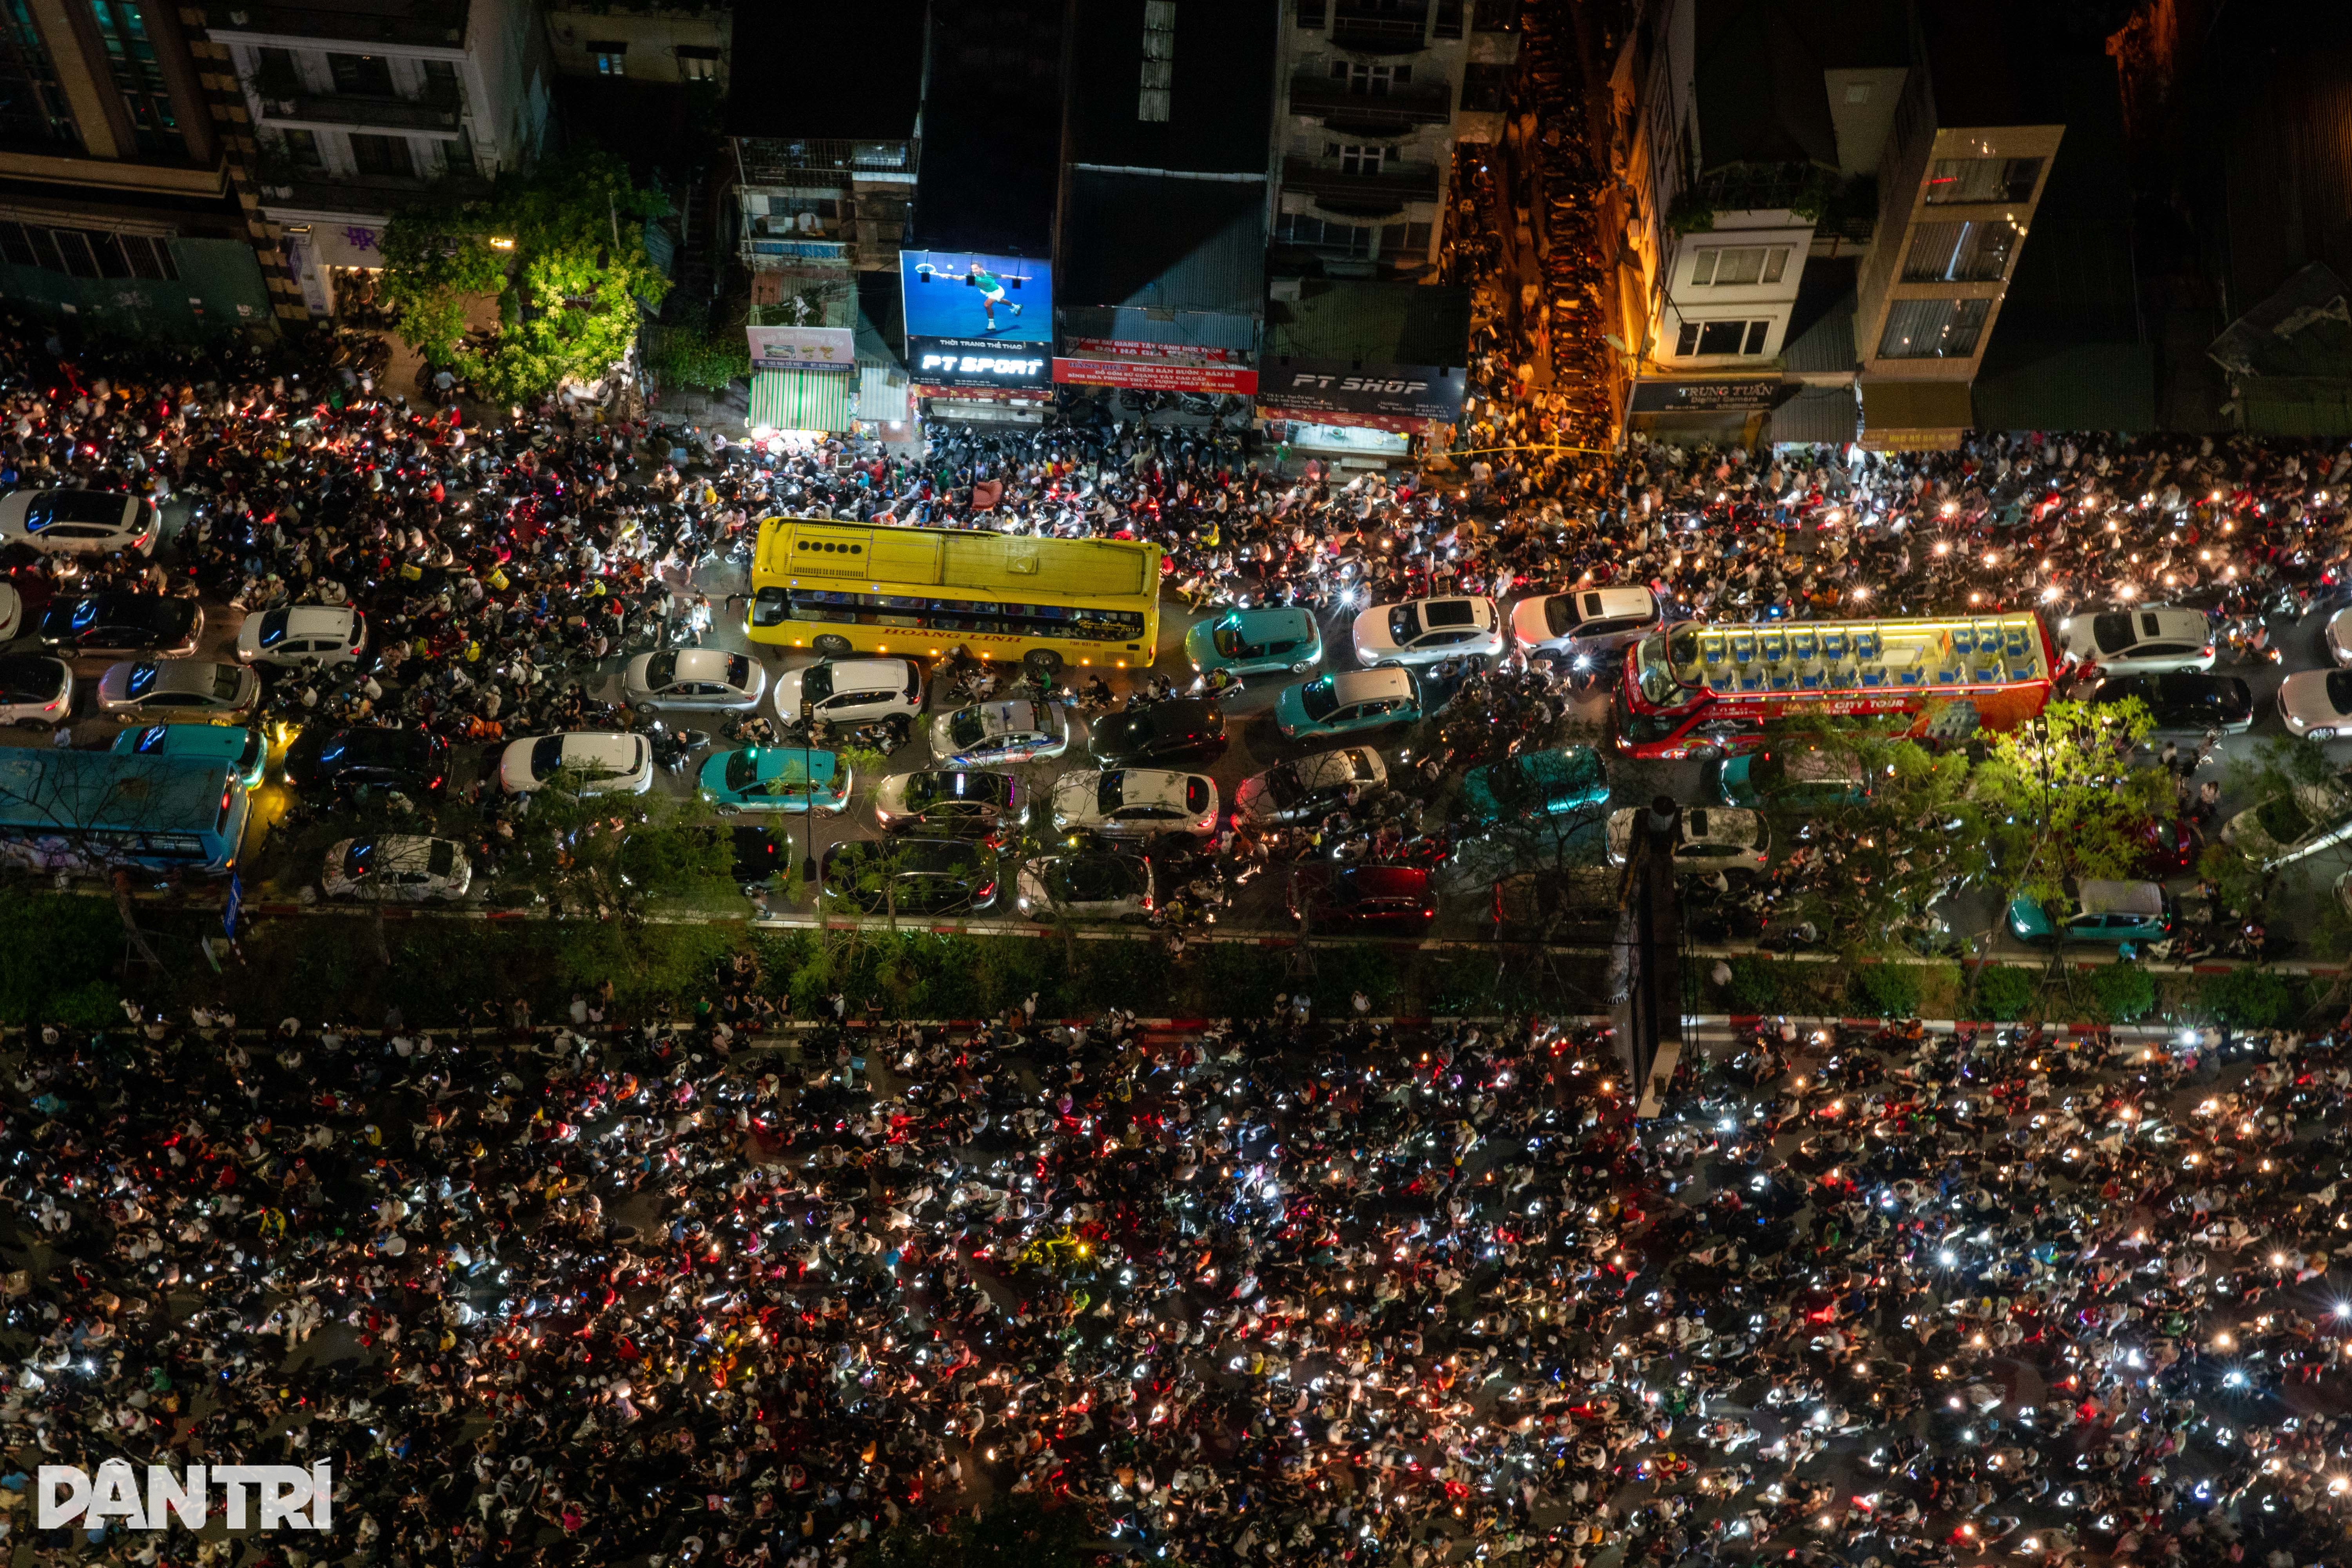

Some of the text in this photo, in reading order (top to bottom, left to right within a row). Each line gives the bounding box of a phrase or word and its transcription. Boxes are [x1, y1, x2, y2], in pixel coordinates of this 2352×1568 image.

[922, 355, 1044, 374] PT SPORT
[1292, 374, 1428, 394] PT SHOP
[1679, 386, 1728, 397] TRUNG
[883, 627, 1022, 642] HOÀNG LINH
[1835, 701, 1865, 710] CITY
[1870, 699, 1904, 708] TOUR
